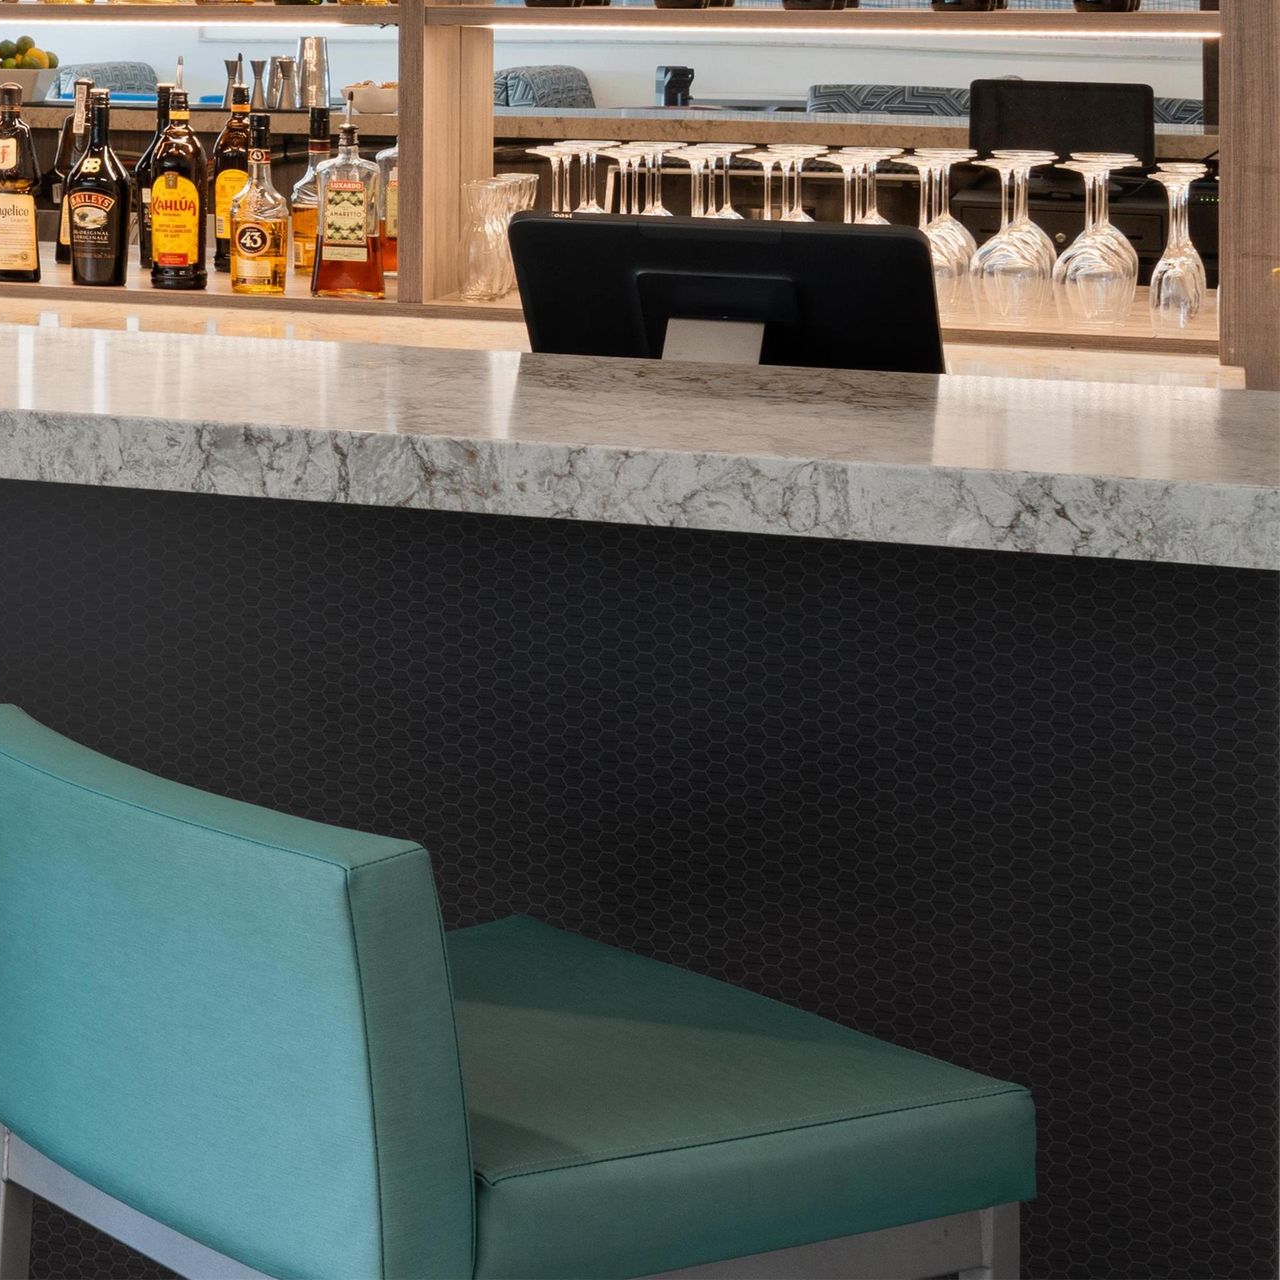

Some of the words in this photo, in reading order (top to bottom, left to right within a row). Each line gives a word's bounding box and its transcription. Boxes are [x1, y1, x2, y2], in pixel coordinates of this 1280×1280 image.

[71, 194, 111, 207] BAILEYS
[152, 196, 197, 216] KAHLÚA
[240, 231, 262, 248] 43
